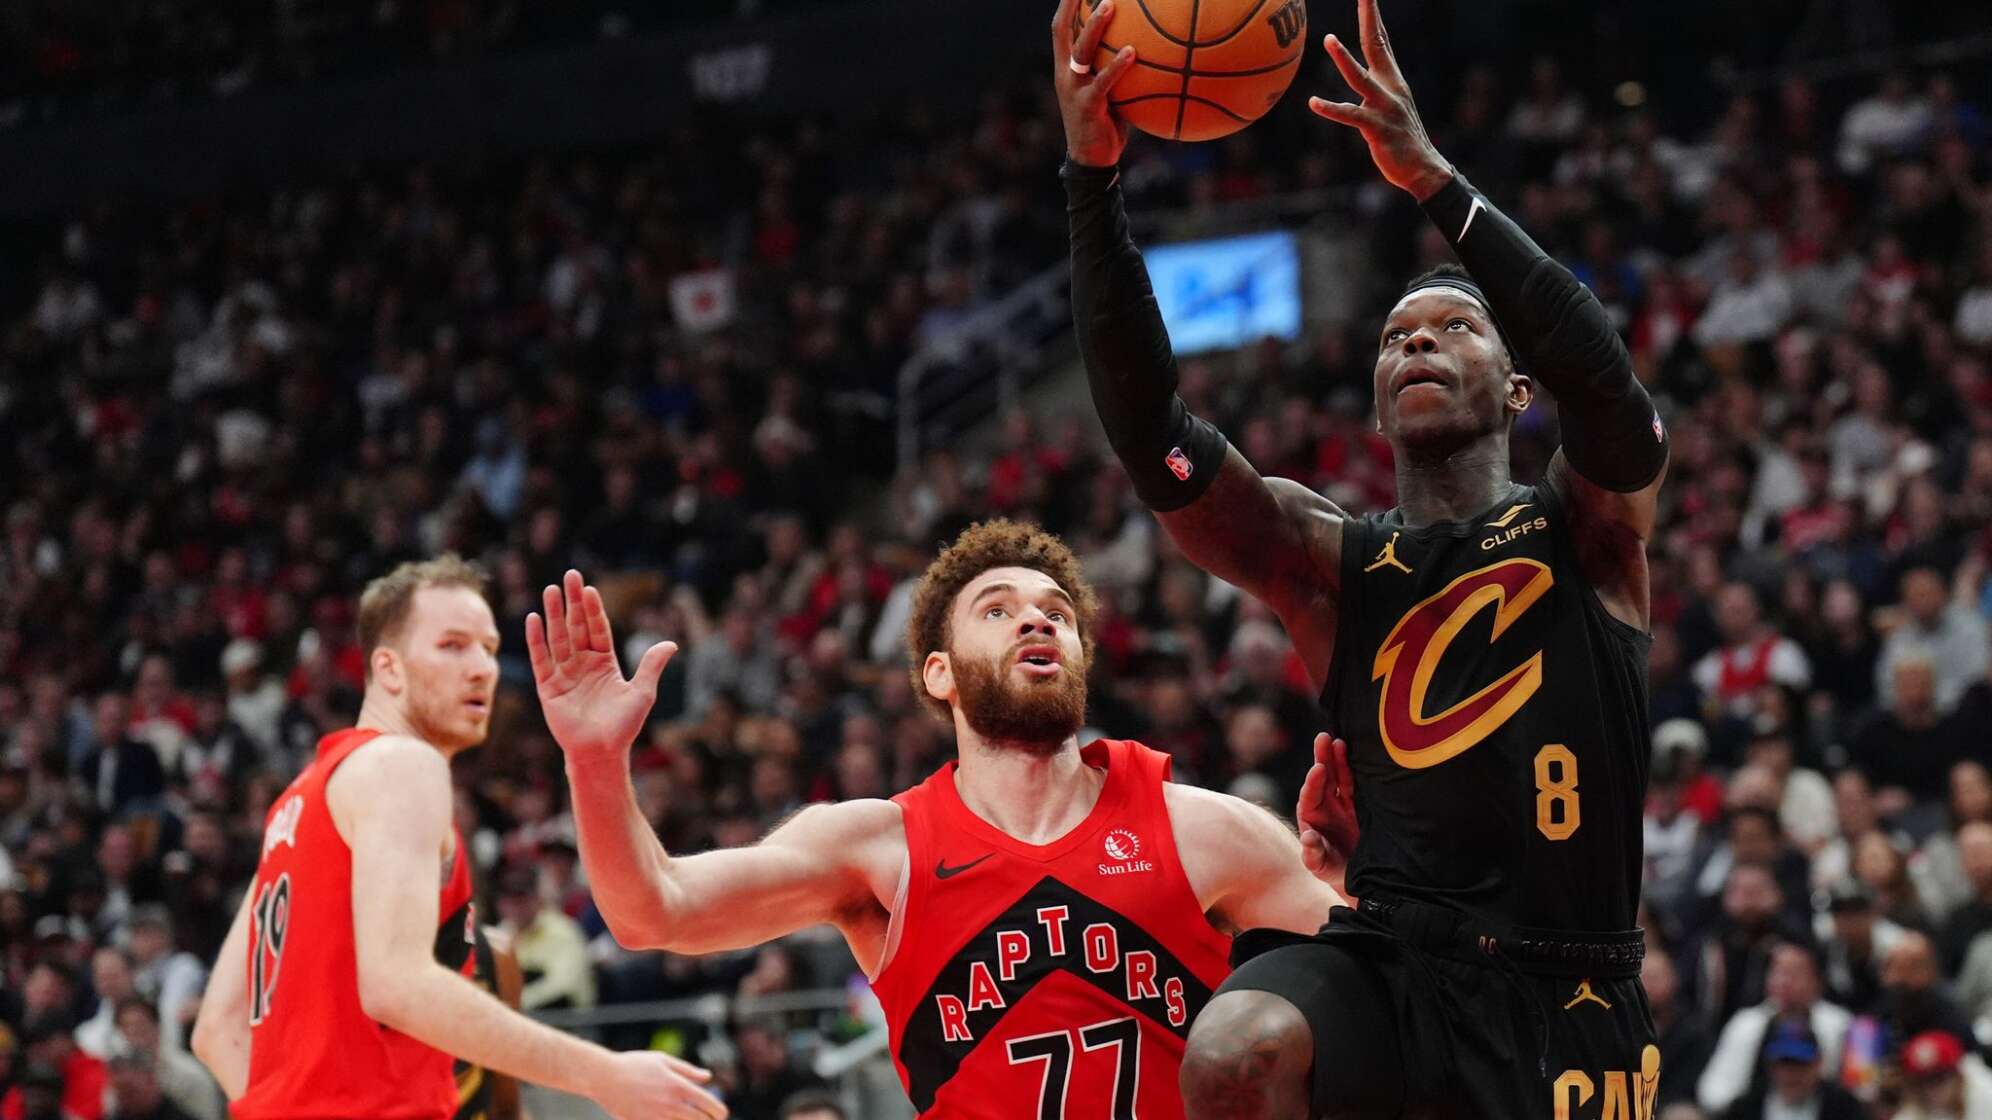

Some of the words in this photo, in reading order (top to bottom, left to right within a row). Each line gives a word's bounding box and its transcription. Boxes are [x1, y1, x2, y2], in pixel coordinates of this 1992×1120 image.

[1481, 517, 1547, 550] CLIFFS
[1372, 557, 1554, 770] C
[1534, 743, 1581, 841] 8
[1098, 863, 1125, 876] Sun
[1126, 860, 1152, 873] Life
[249, 871, 291, 1026] 19
[936, 905, 1187, 1042] RAPTORS
[1005, 1016, 1142, 1120] 77
